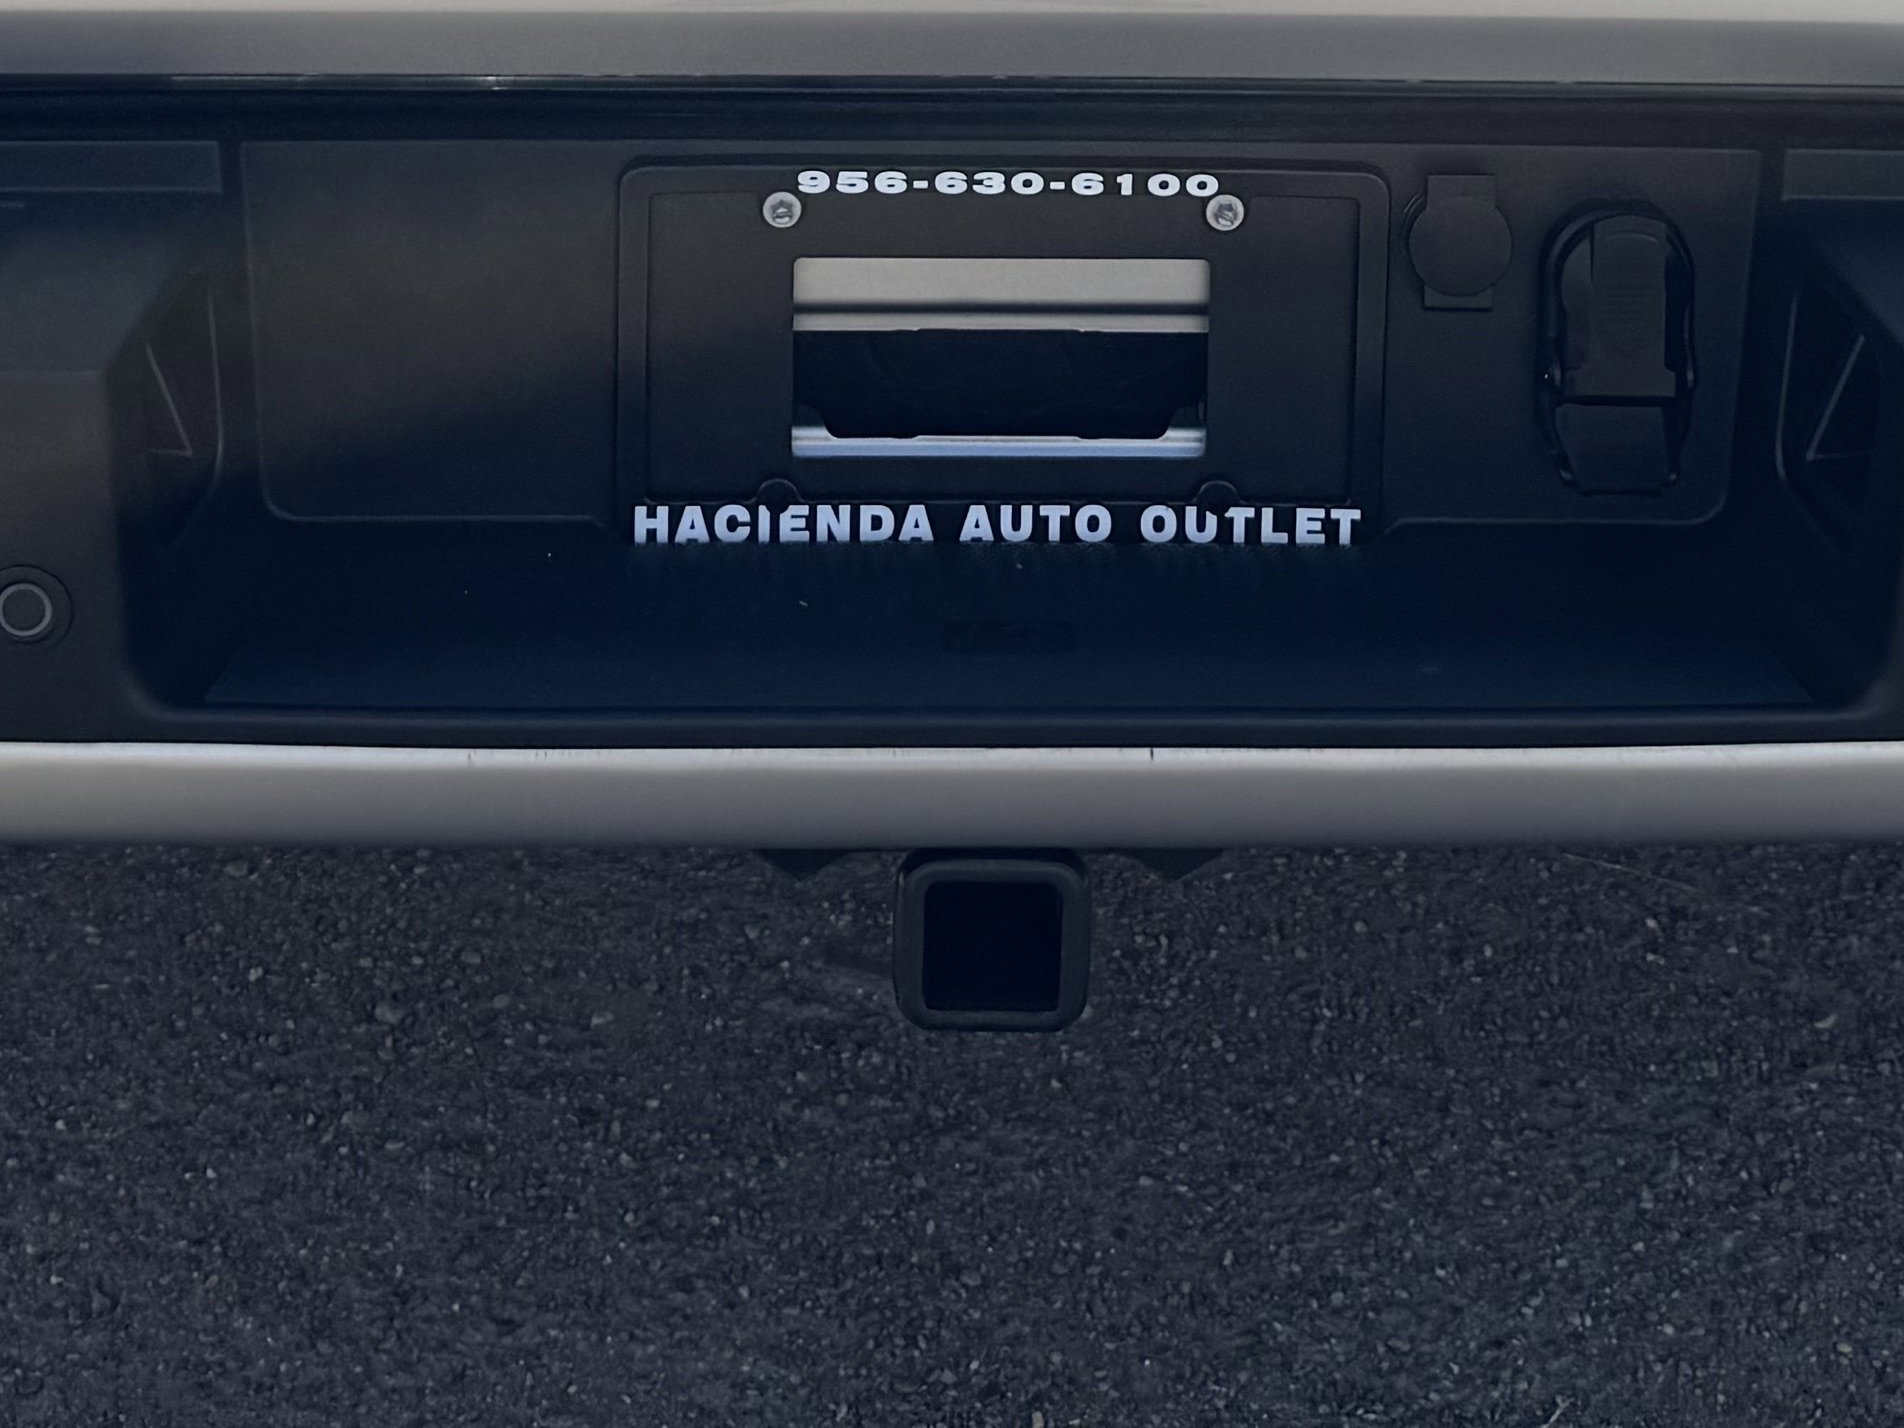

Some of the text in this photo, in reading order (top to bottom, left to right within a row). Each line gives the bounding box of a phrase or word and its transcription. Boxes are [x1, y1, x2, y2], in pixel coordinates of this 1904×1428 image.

[795, 169, 1221, 198] 956-630-6100
[632, 504, 1363, 546] HACIENDA AUTO OUTLET
